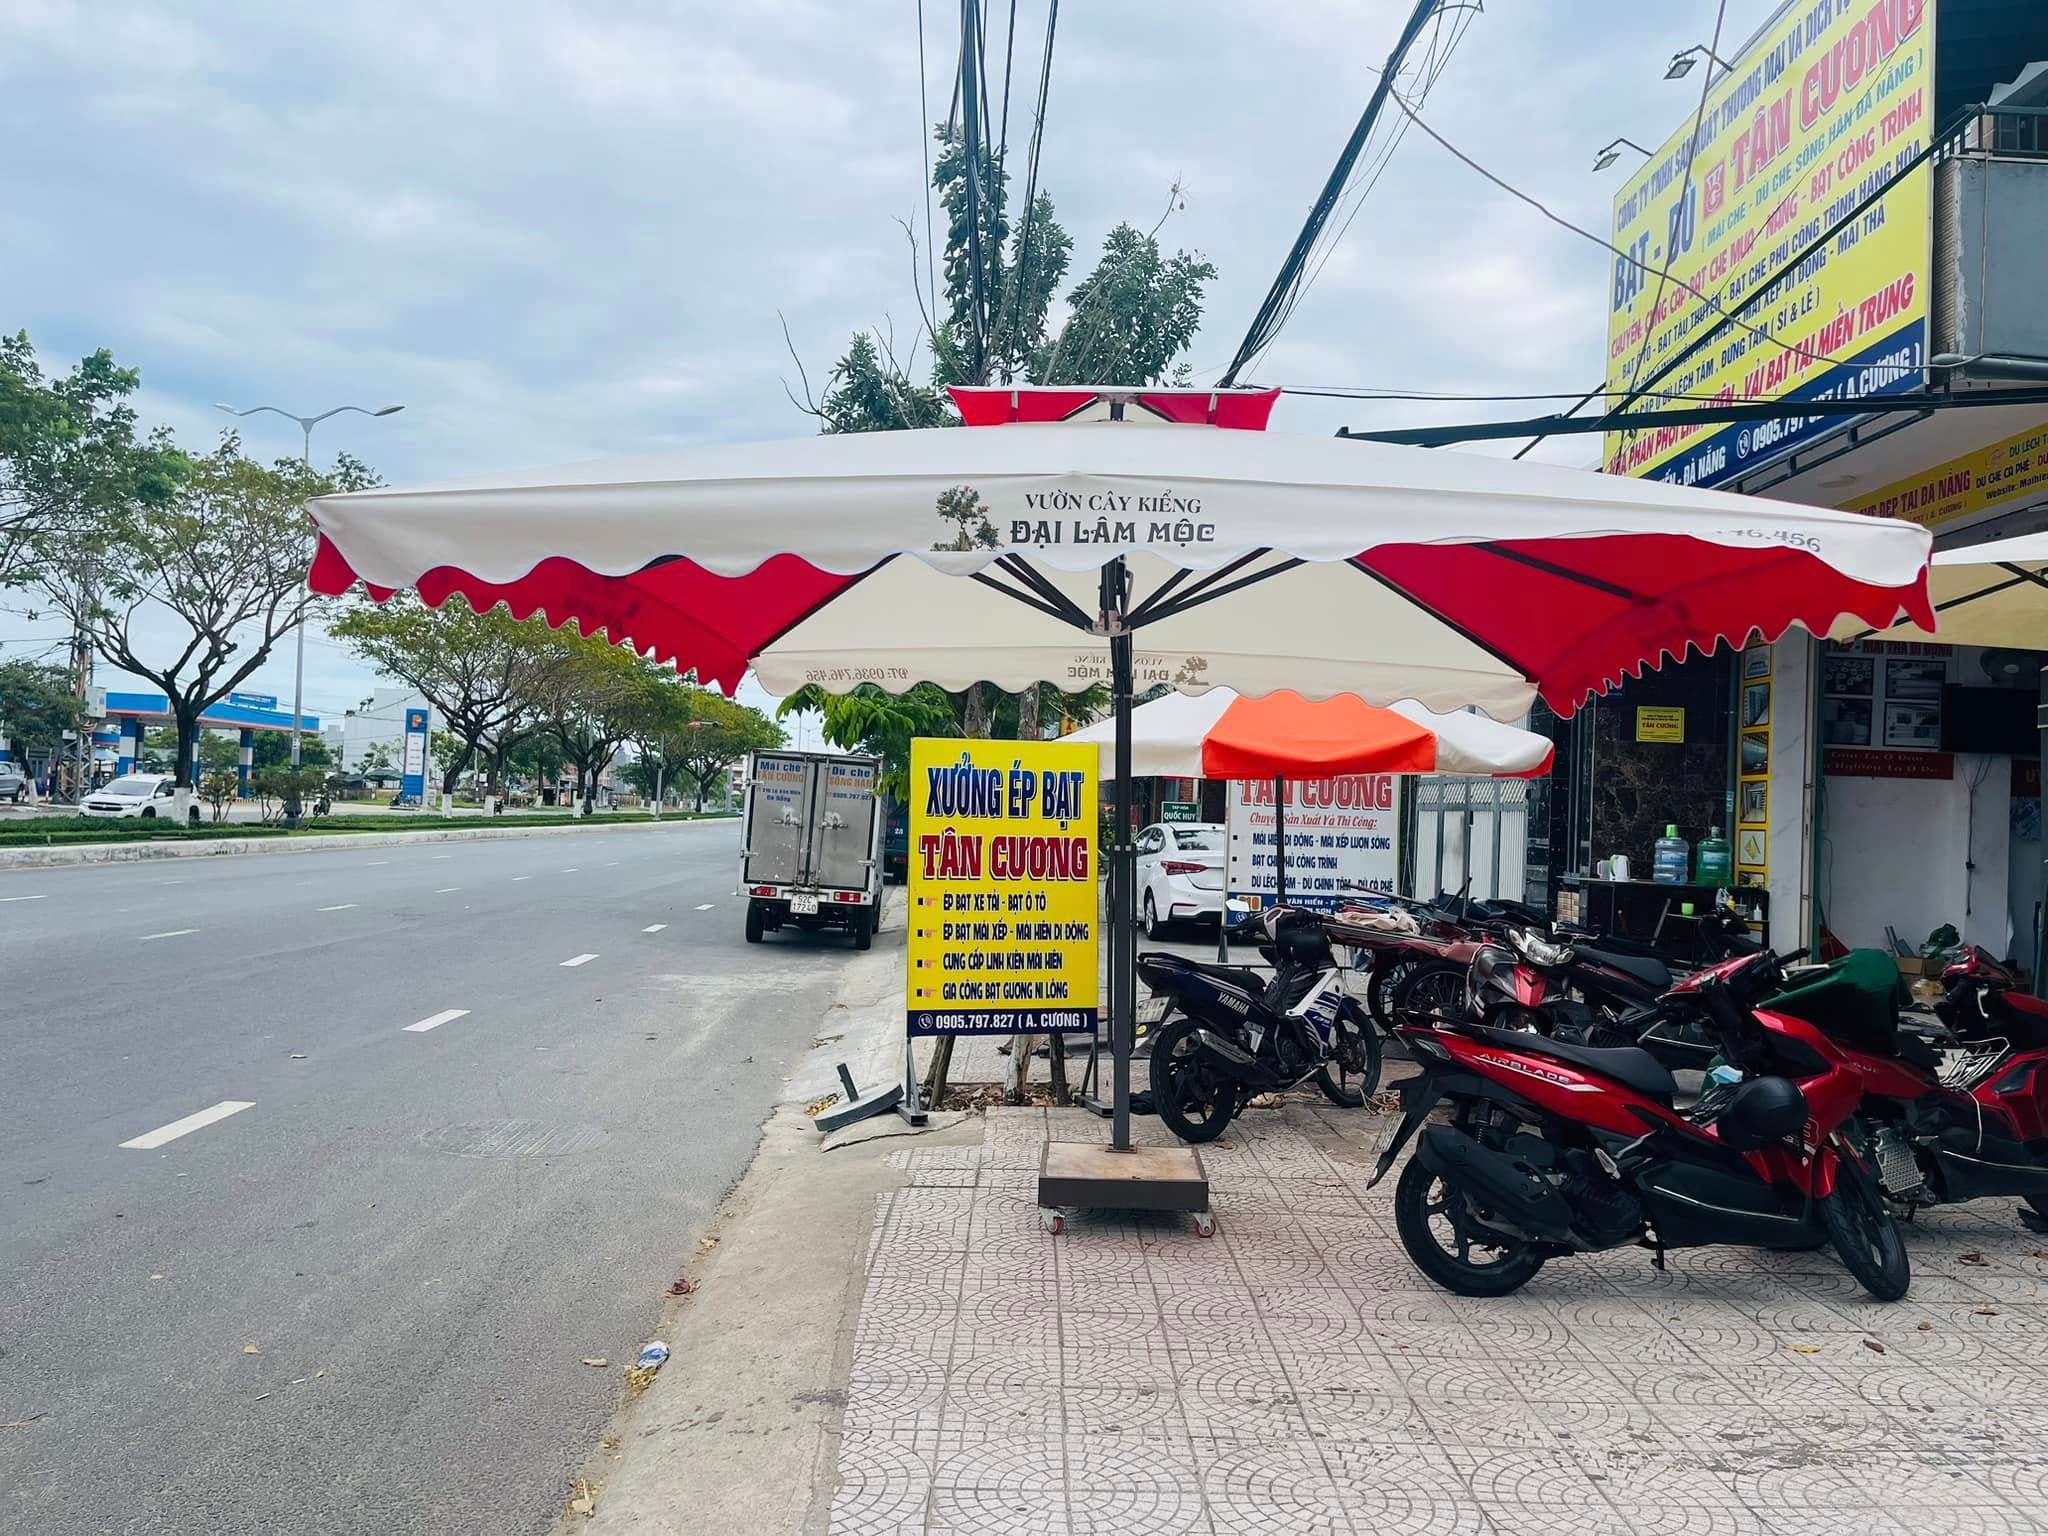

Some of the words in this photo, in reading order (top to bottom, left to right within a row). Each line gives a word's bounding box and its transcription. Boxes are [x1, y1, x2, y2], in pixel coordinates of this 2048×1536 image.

[1764, 40, 1785, 88] MẠI
[1789, 18, 1802, 64] VÀ
[1732, 88, 1792, 194] TÂN
[1800, 0, 1923, 132] CƯƠNG
[1709, 249, 1727, 282] CHE
[1810, 161, 1834, 204] BẠT
[1837, 127, 1875, 180] CÔNG
[1880, 88, 1922, 146] TRÌNH
[1727, 201, 1746, 230] CHE
[1772, 162, 1792, 192] CHE
[1795, 133, 1825, 172] SÔNG
[1837, 222, 1859, 256] MÁI
[1614, 230, 1649, 313] BẠT
[1658, 329, 1672, 353] BẠT
[1730, 273, 1746, 300] BẠT
[1749, 257, 1767, 285] CHE
[1792, 216, 1820, 253] CÔNG
[1823, 188, 1856, 231] TRÌNH
[1859, 161, 1892, 203] HÀNG
[1766, 350, 1790, 393] BẠT
[1794, 333, 1816, 379] TẠI
[1818, 301, 1855, 358] MIỀN
[1858, 272, 1914, 336] TRUNG
[1696, 357, 1714, 386] TÂM
[1699, 445, 1726, 480] NẴNG
[1939, 468, 1970, 500] NẴNG
[1025, 489, 1082, 511] VƯỜN
[1088, 491, 1133, 512] CÂY
[1138, 489, 1202, 514] KIỂNG
[1010, 520, 1062, 549] ĐẠI
[1073, 516, 1136, 544] LÂM
[1148, 518, 1215, 548] MỘC
[926, 752, 1003, 818] XƯỞNG
[1008, 760, 1036, 819] ÉP
[1042, 770, 1085, 829] BẠT
[1164, 810, 1181, 820] QUỐC
[1337, 815, 1351, 827] Thi
[919, 827, 983, 880] TÂN
[990, 835, 1089, 882] CƯƠNG
[1285, 834, 1292, 846] DI
[1293, 832, 1314, 848] ĐỘNG
[1252, 854, 1265, 869] BẠT
[1296, 853, 1316, 868] CÔNG
[1318, 854, 1338, 870] TRÌNH
[1302, 876, 1313, 890] DÙ
[943, 889, 953, 911] ÉP
[956, 894, 971, 915] BẠT
[974, 894, 984, 911] XE
[987, 888, 1000, 911] TẢI
[1008, 894, 1023, 915] BẠT
[1026, 890, 1032, 911] Ô
[1035, 890, 1046, 911] TÔ
[943, 919, 953, 940] ÉP
[956, 923, 971, 944] BẠT
[973, 919, 989, 940] MÁI
[992, 917, 1008, 940] XẾP
[1016, 919, 1031, 940] MÁI
[1034, 919, 1051, 940] HIÊN
[1054, 923, 1063, 940] DI
[1065, 919, 1089, 944] ĐỘNG
[943, 953, 966, 970] CUNG
[968, 946, 984, 970] CẤP
[986, 953, 1004, 970] LINH
[1006, 949, 1025, 973] KIỆN
[1026, 949, 1042, 969] MÁI
[1045, 949, 1063, 969] HIÊN
[943, 982, 956, 1000] GIA
[959, 979, 982, 1000] CÔNG
[985, 982, 1000, 1003] BẠT
[1035, 982, 1044, 999] NI
[1045, 978, 1068, 999] LÔNG
[1218, 991, 1250, 1015] YAMAHA
[936, 1014, 1014, 1029] 0905.797.827
[1026, 1016, 1037, 1028] A.
[1041, 1011, 1080, 1027] CƯƠNG
[1479, 1053, 1570, 1084] AIRBLADE
